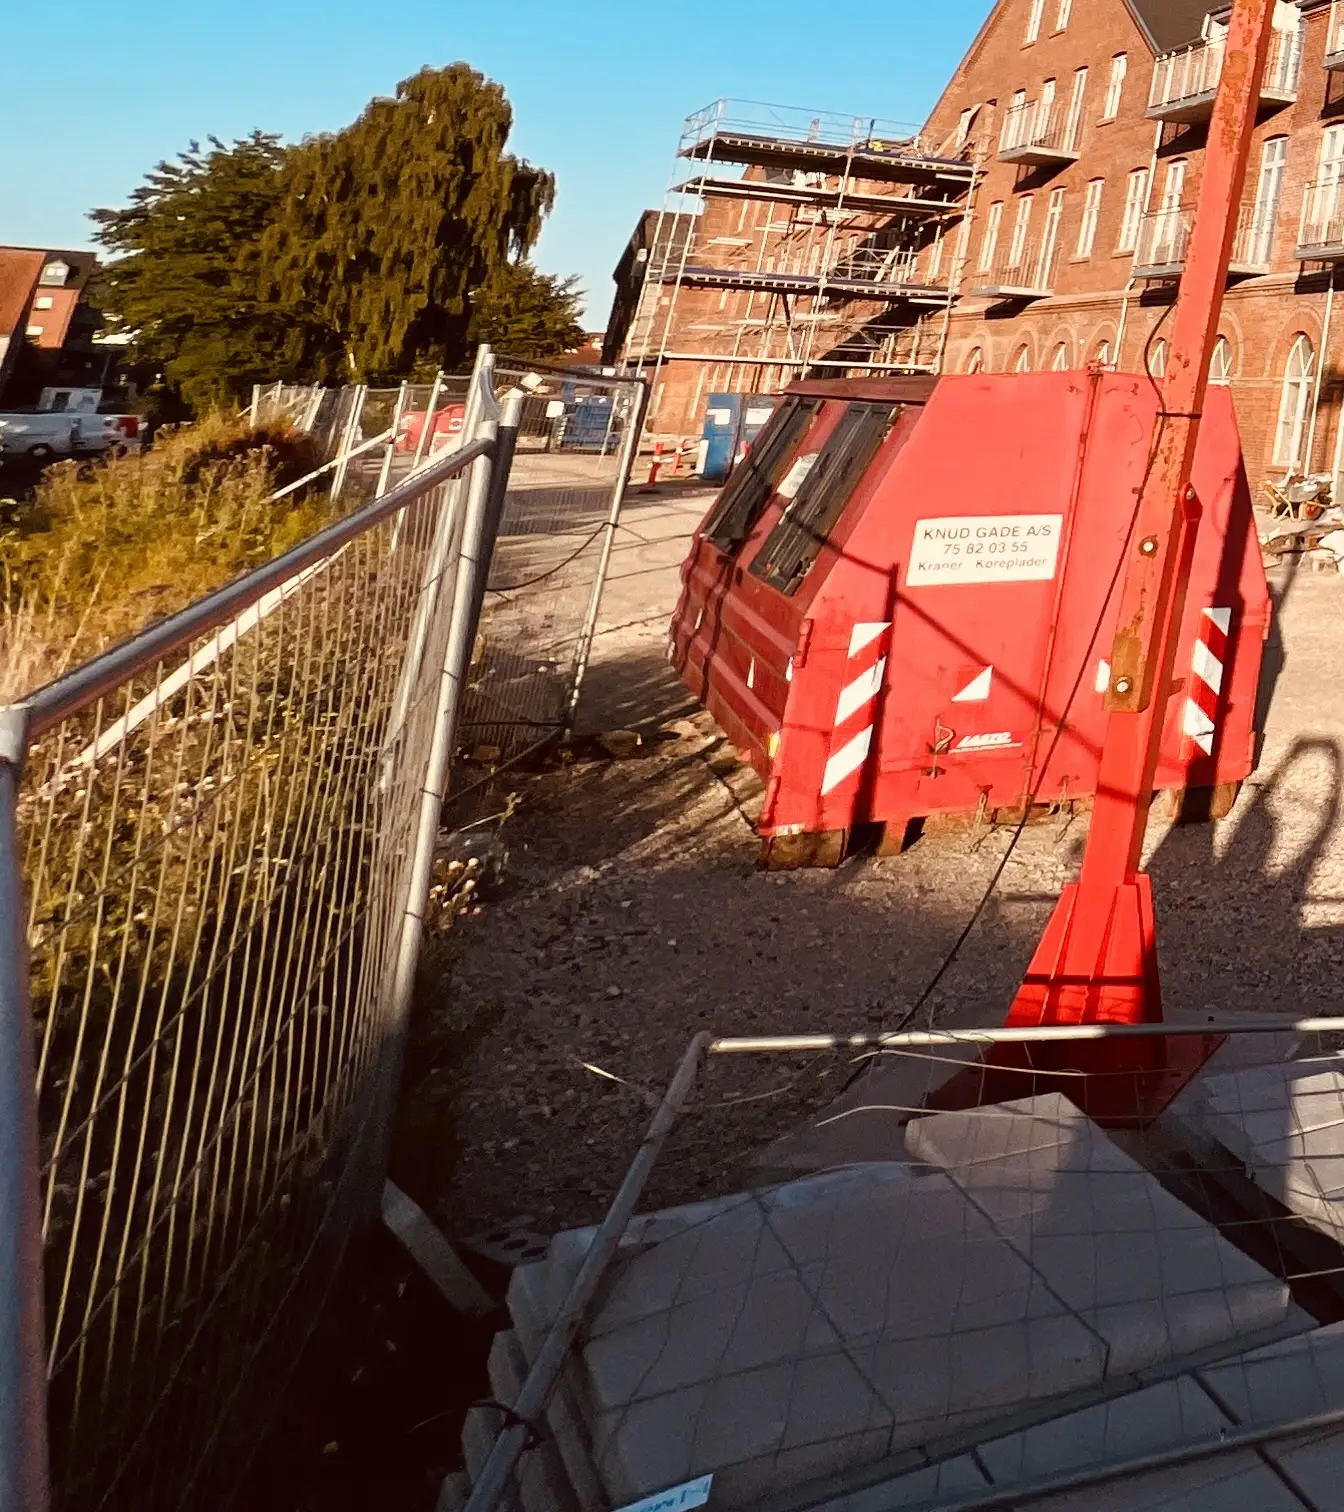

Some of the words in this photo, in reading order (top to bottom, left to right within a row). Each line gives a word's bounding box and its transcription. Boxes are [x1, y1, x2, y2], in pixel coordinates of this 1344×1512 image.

[924, 527, 970, 539] KNUD
[975, 526, 1020, 538] GADE
[1026, 525, 1052, 536] A/S
[944, 543, 961, 555] 75
[965, 542, 984, 555] 82
[988, 541, 1006, 554] 03
[1011, 541, 1028, 553] 55
[918, 560, 963, 571] Kraner
